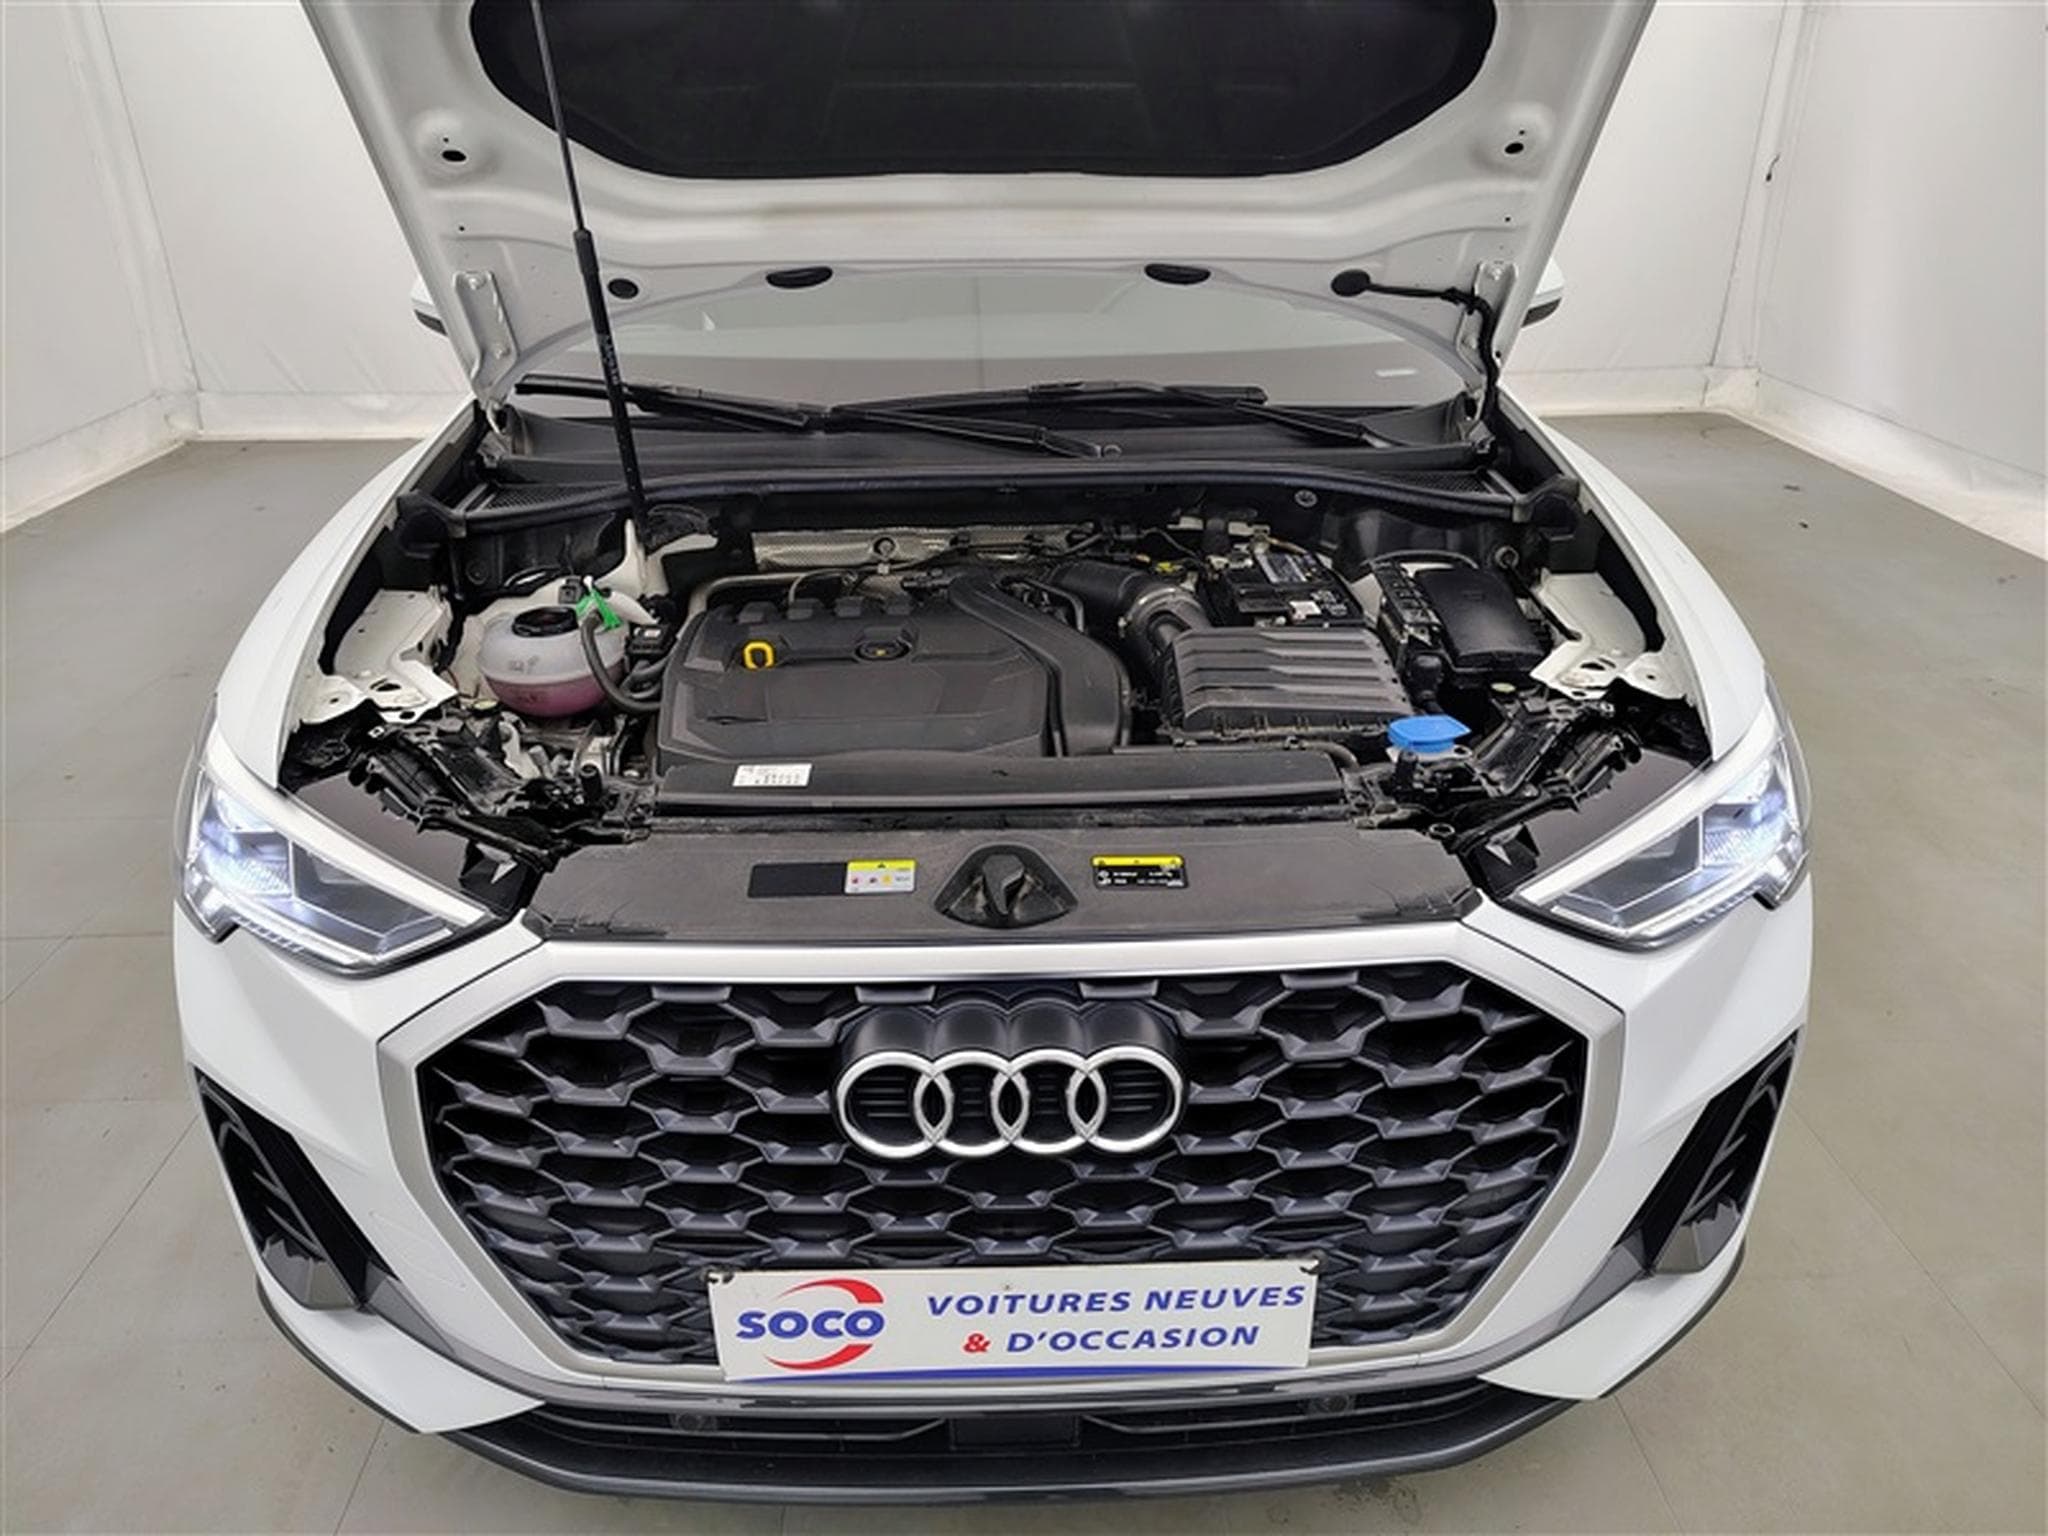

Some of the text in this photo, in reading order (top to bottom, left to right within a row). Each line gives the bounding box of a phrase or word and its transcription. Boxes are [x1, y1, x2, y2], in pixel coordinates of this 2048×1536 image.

[929, 1284, 1305, 1317] VOITURES NEUVES
[736, 1308, 886, 1341] SOCO
[963, 1326, 1259, 1354] & D'OCCASION
